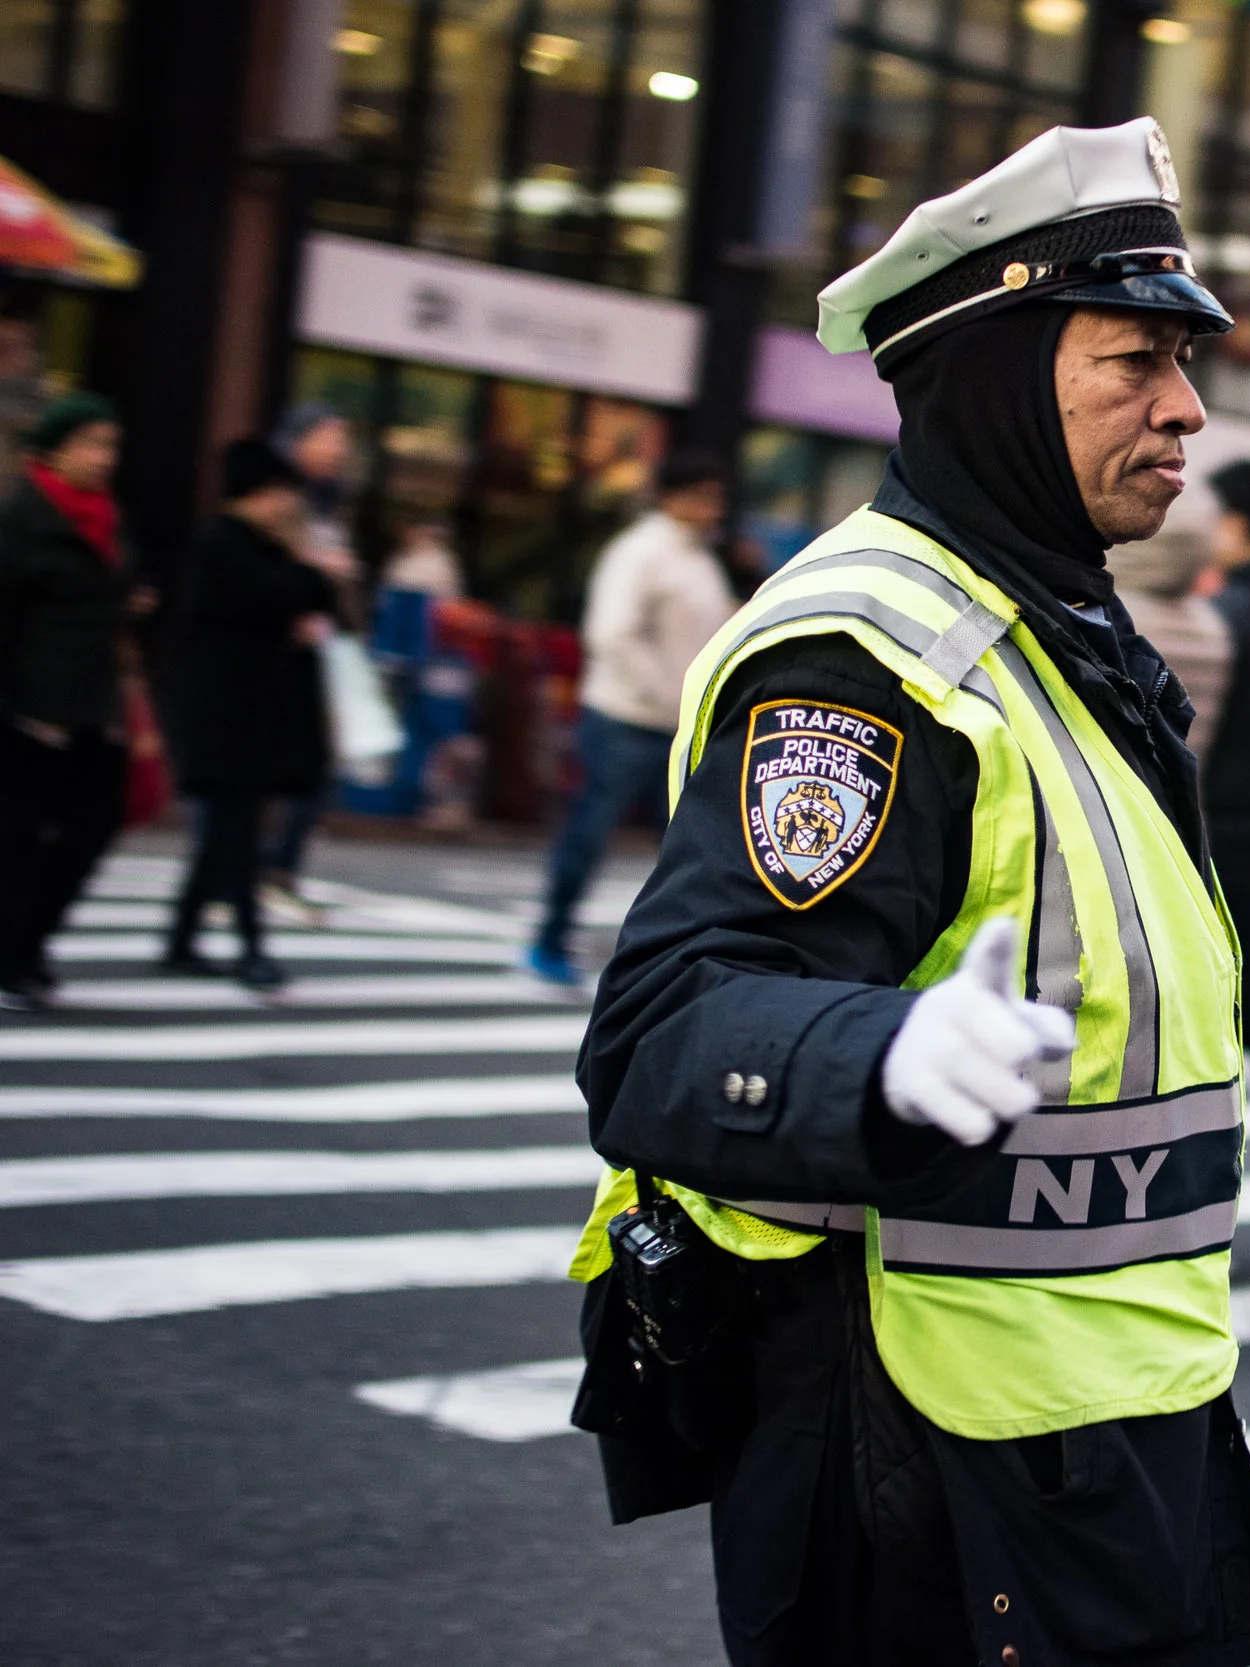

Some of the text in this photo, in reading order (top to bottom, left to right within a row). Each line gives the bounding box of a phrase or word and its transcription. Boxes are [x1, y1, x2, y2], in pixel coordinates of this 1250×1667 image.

[775, 708, 878, 746] TRAFFIC
[782, 738, 859, 769] POLICE
[754, 756, 881, 800] DEPARTMENT
[750, 806, 785, 875] CITY OF
[807, 811, 877, 888] NEW YORK
[1008, 1149, 1170, 1224] NY
